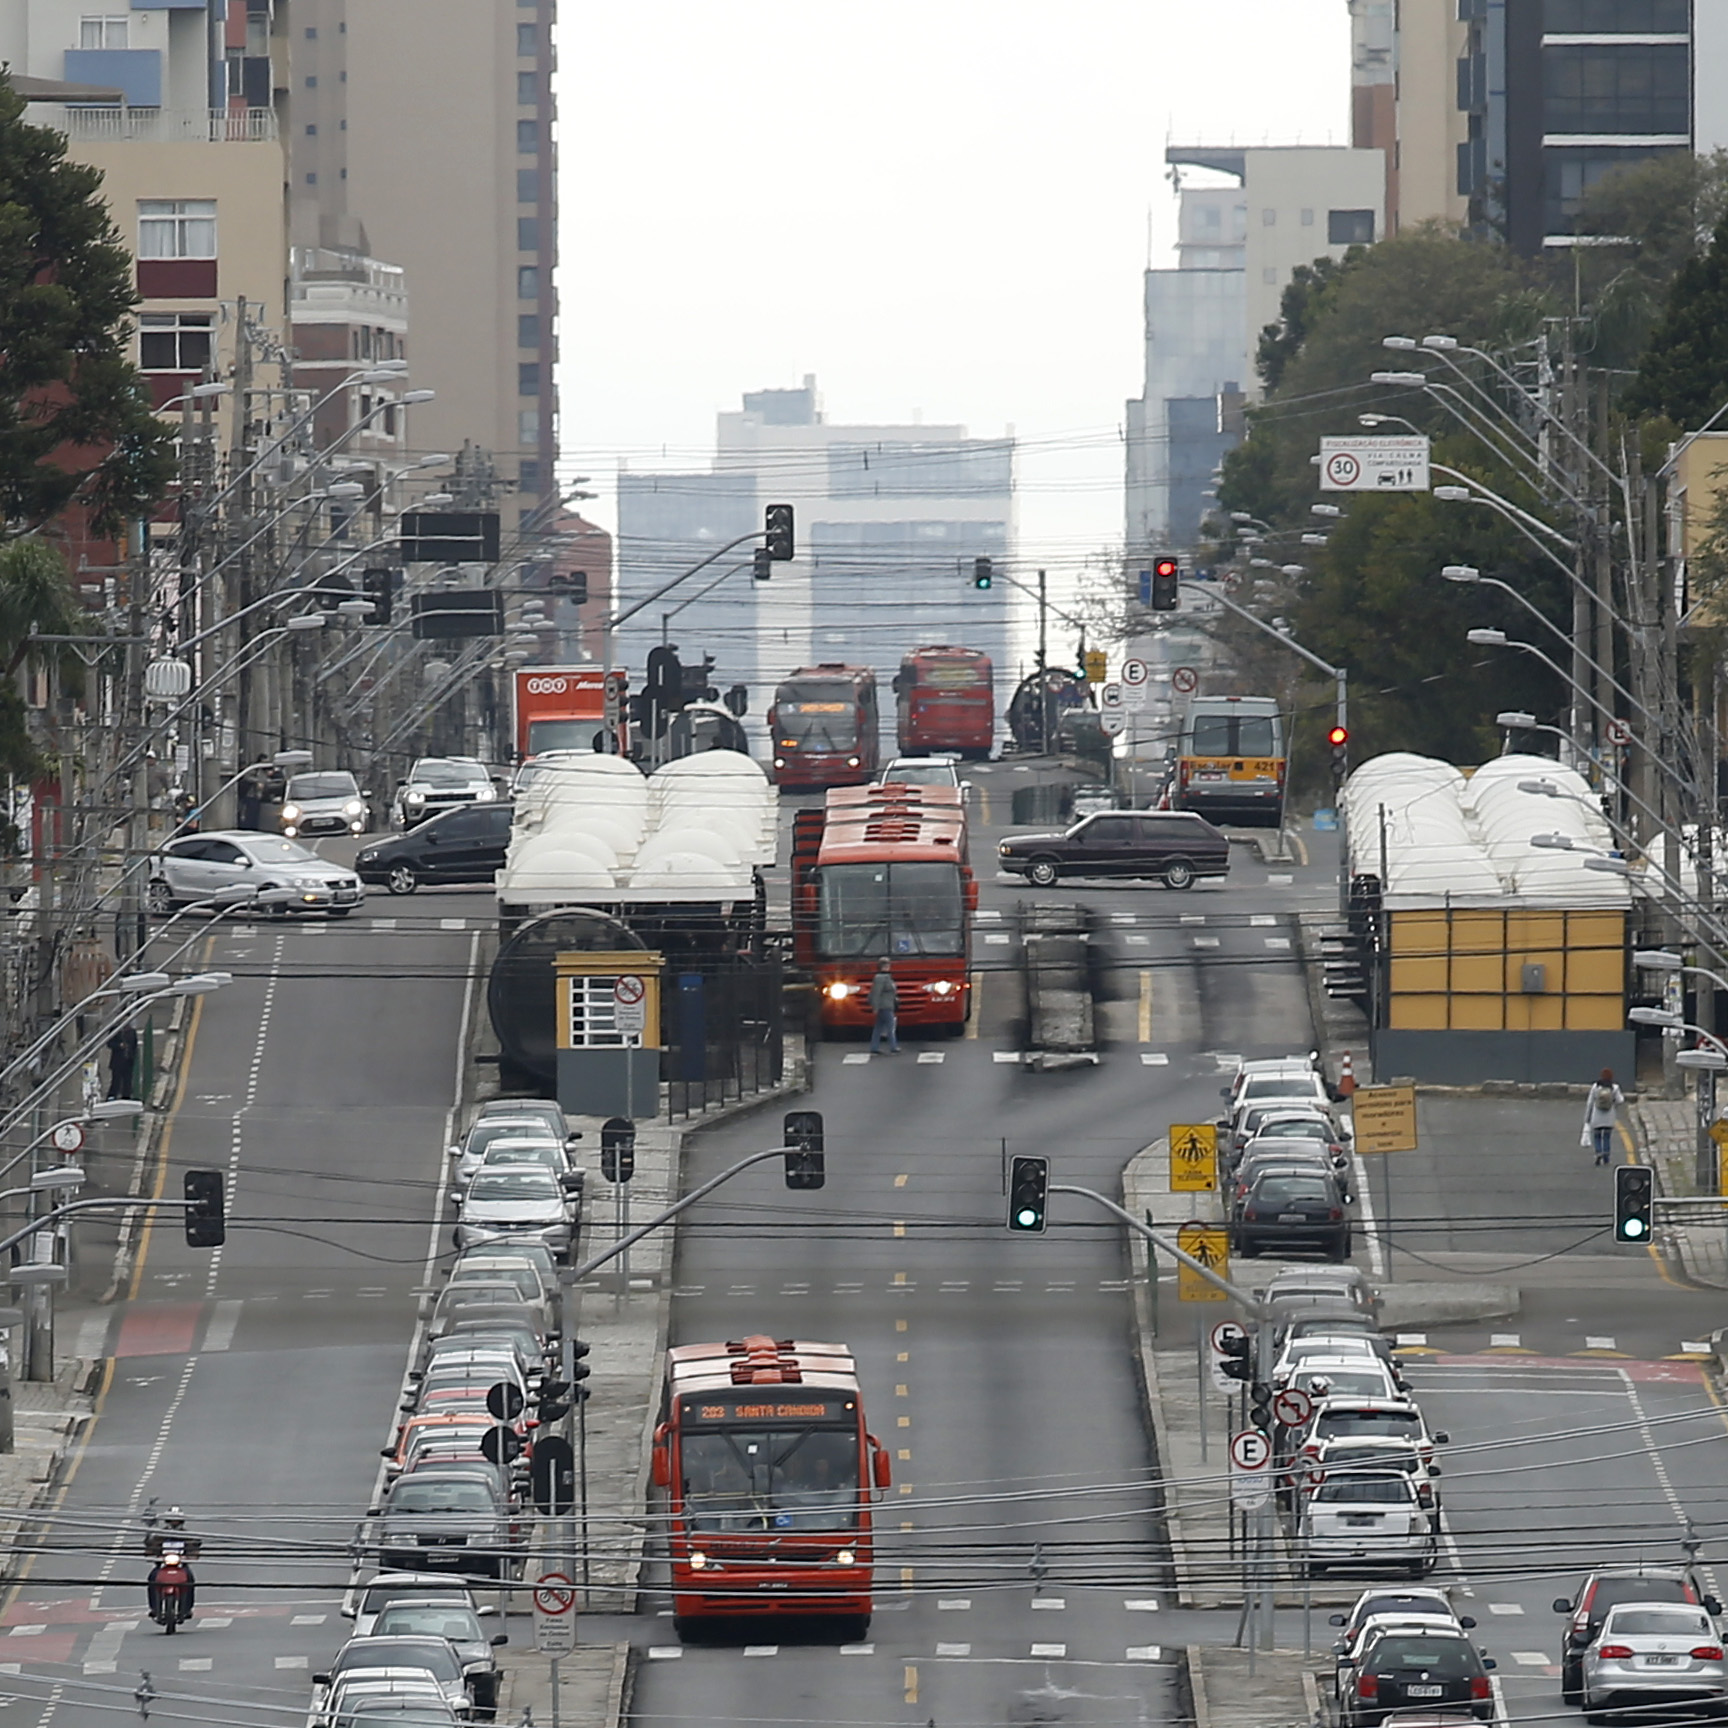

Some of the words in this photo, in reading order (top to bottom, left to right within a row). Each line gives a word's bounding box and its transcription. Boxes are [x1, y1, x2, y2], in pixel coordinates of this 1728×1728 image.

[1334, 460, 1354, 475] 30
[1129, 663, 1140, 680] E
[735, 1405, 774, 1418] SANTA
[1243, 1439, 1258, 1462] E
